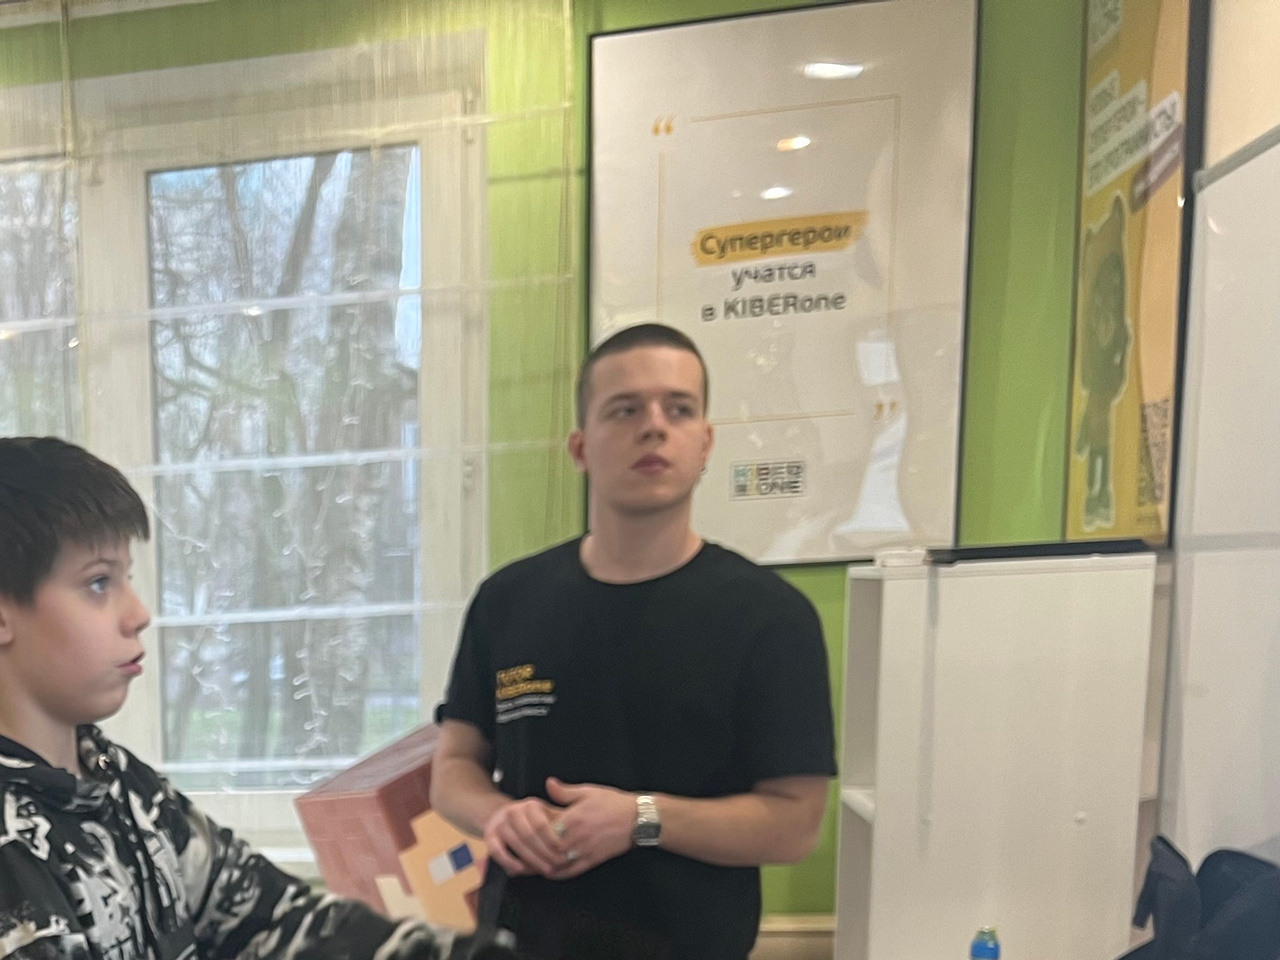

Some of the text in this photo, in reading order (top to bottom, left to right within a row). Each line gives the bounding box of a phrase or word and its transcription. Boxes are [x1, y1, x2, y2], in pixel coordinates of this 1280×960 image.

[699, 225, 851, 259] Супергерои
[731, 261, 816, 291] учатся
[701, 291, 847, 322] в KIBERone
